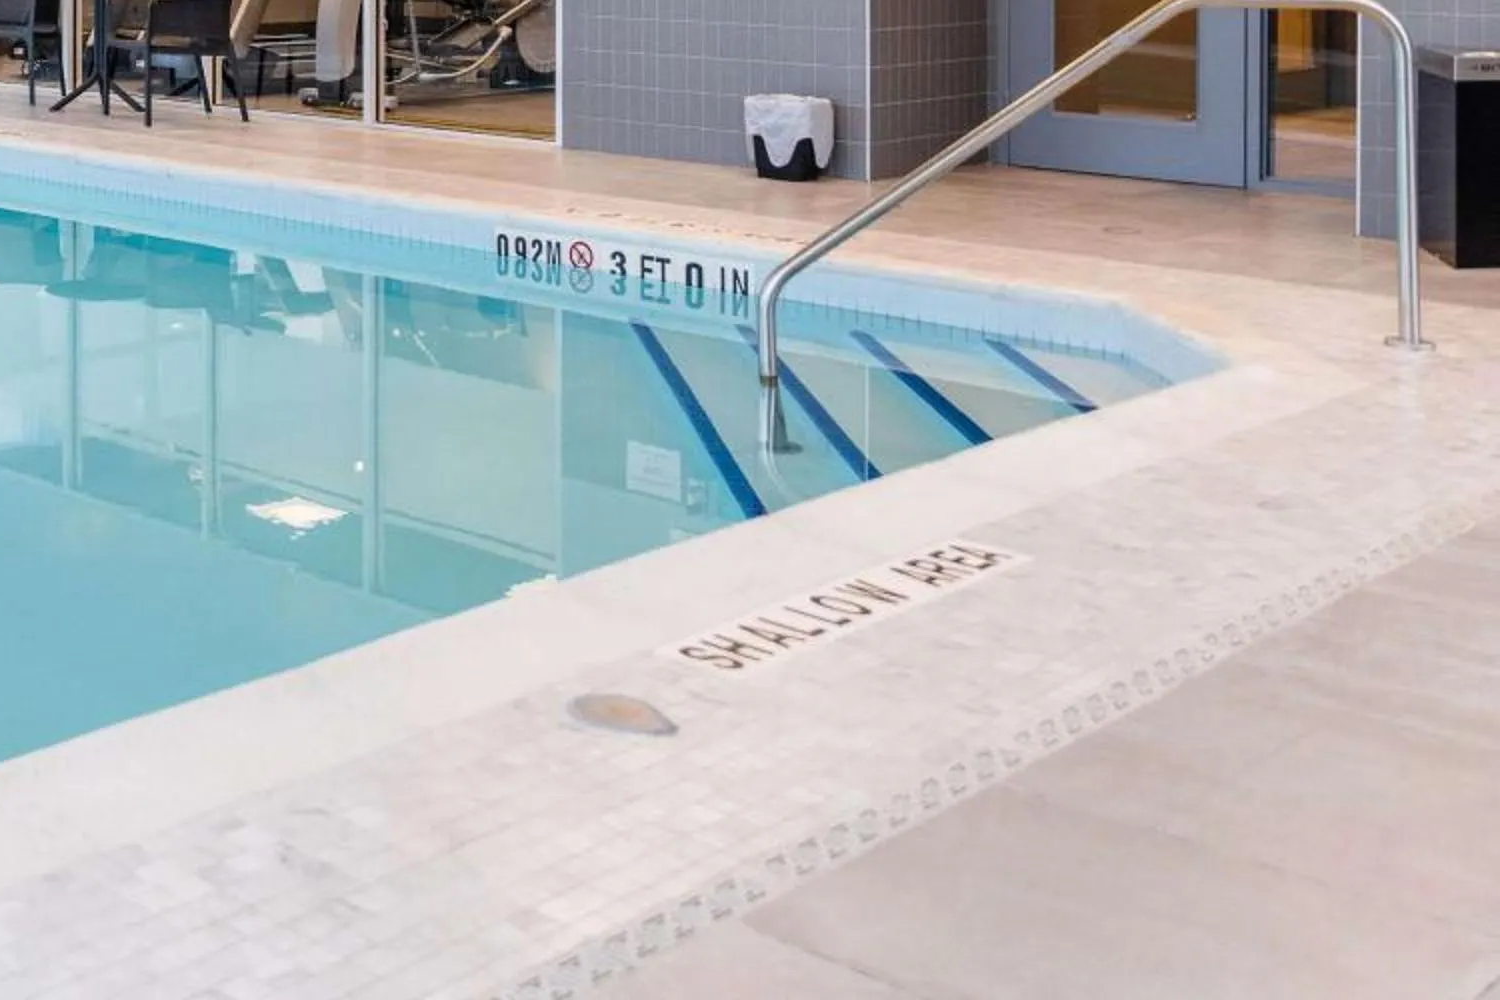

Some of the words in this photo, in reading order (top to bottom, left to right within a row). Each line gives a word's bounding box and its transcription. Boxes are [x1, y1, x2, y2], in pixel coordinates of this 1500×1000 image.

[720, 266, 749, 311] IN
[678, 577, 910, 670] SHALLOW
[890, 543, 1013, 587] AREA
